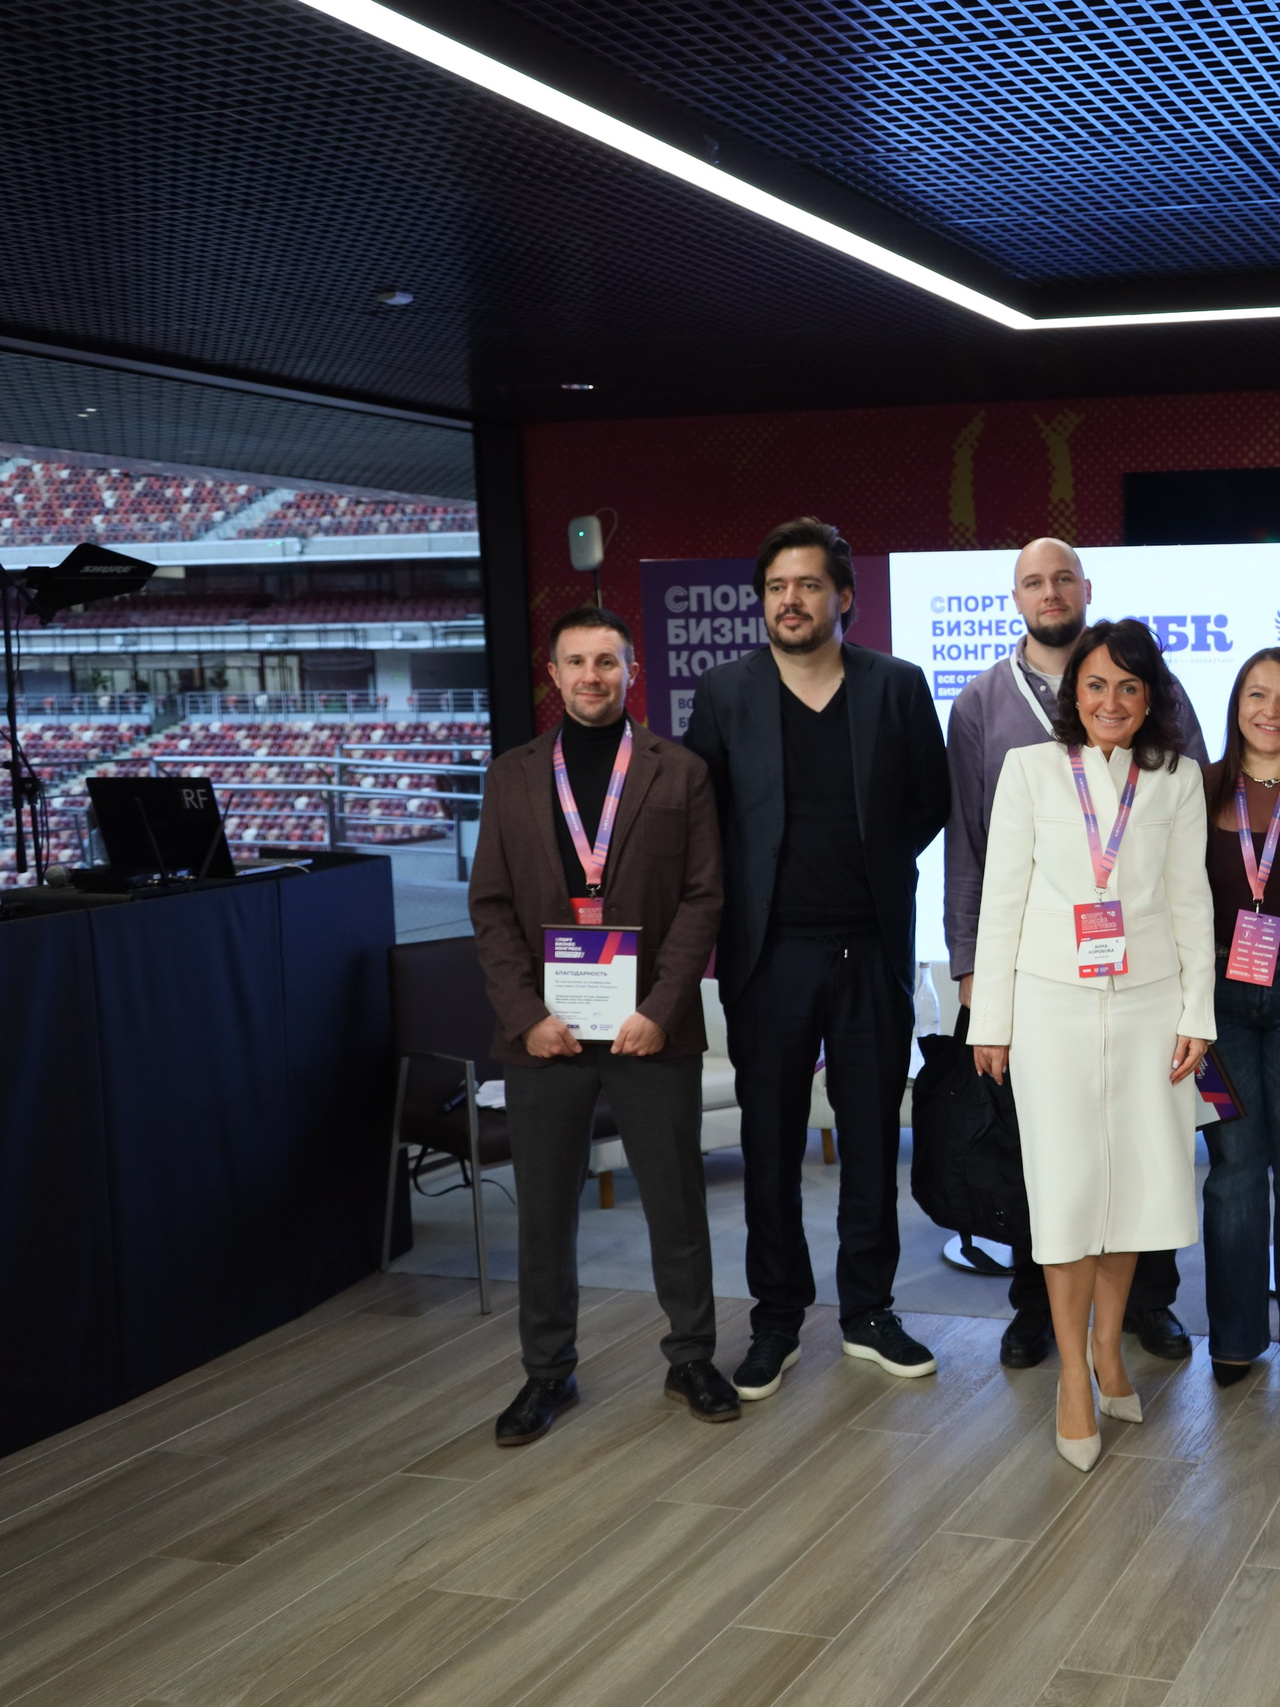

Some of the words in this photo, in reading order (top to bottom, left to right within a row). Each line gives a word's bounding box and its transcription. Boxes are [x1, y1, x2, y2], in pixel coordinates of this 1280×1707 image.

[80, 565, 133, 573] SHURE
[665, 585, 758, 613] СПОР
[930, 595, 1009, 613] СПОРТ
[667, 617, 771, 644] БИЗН
[932, 619, 1023, 637] БИЗНЕС
[933, 644, 1017, 660] КОНГР
[182, 788, 207, 809] RF
